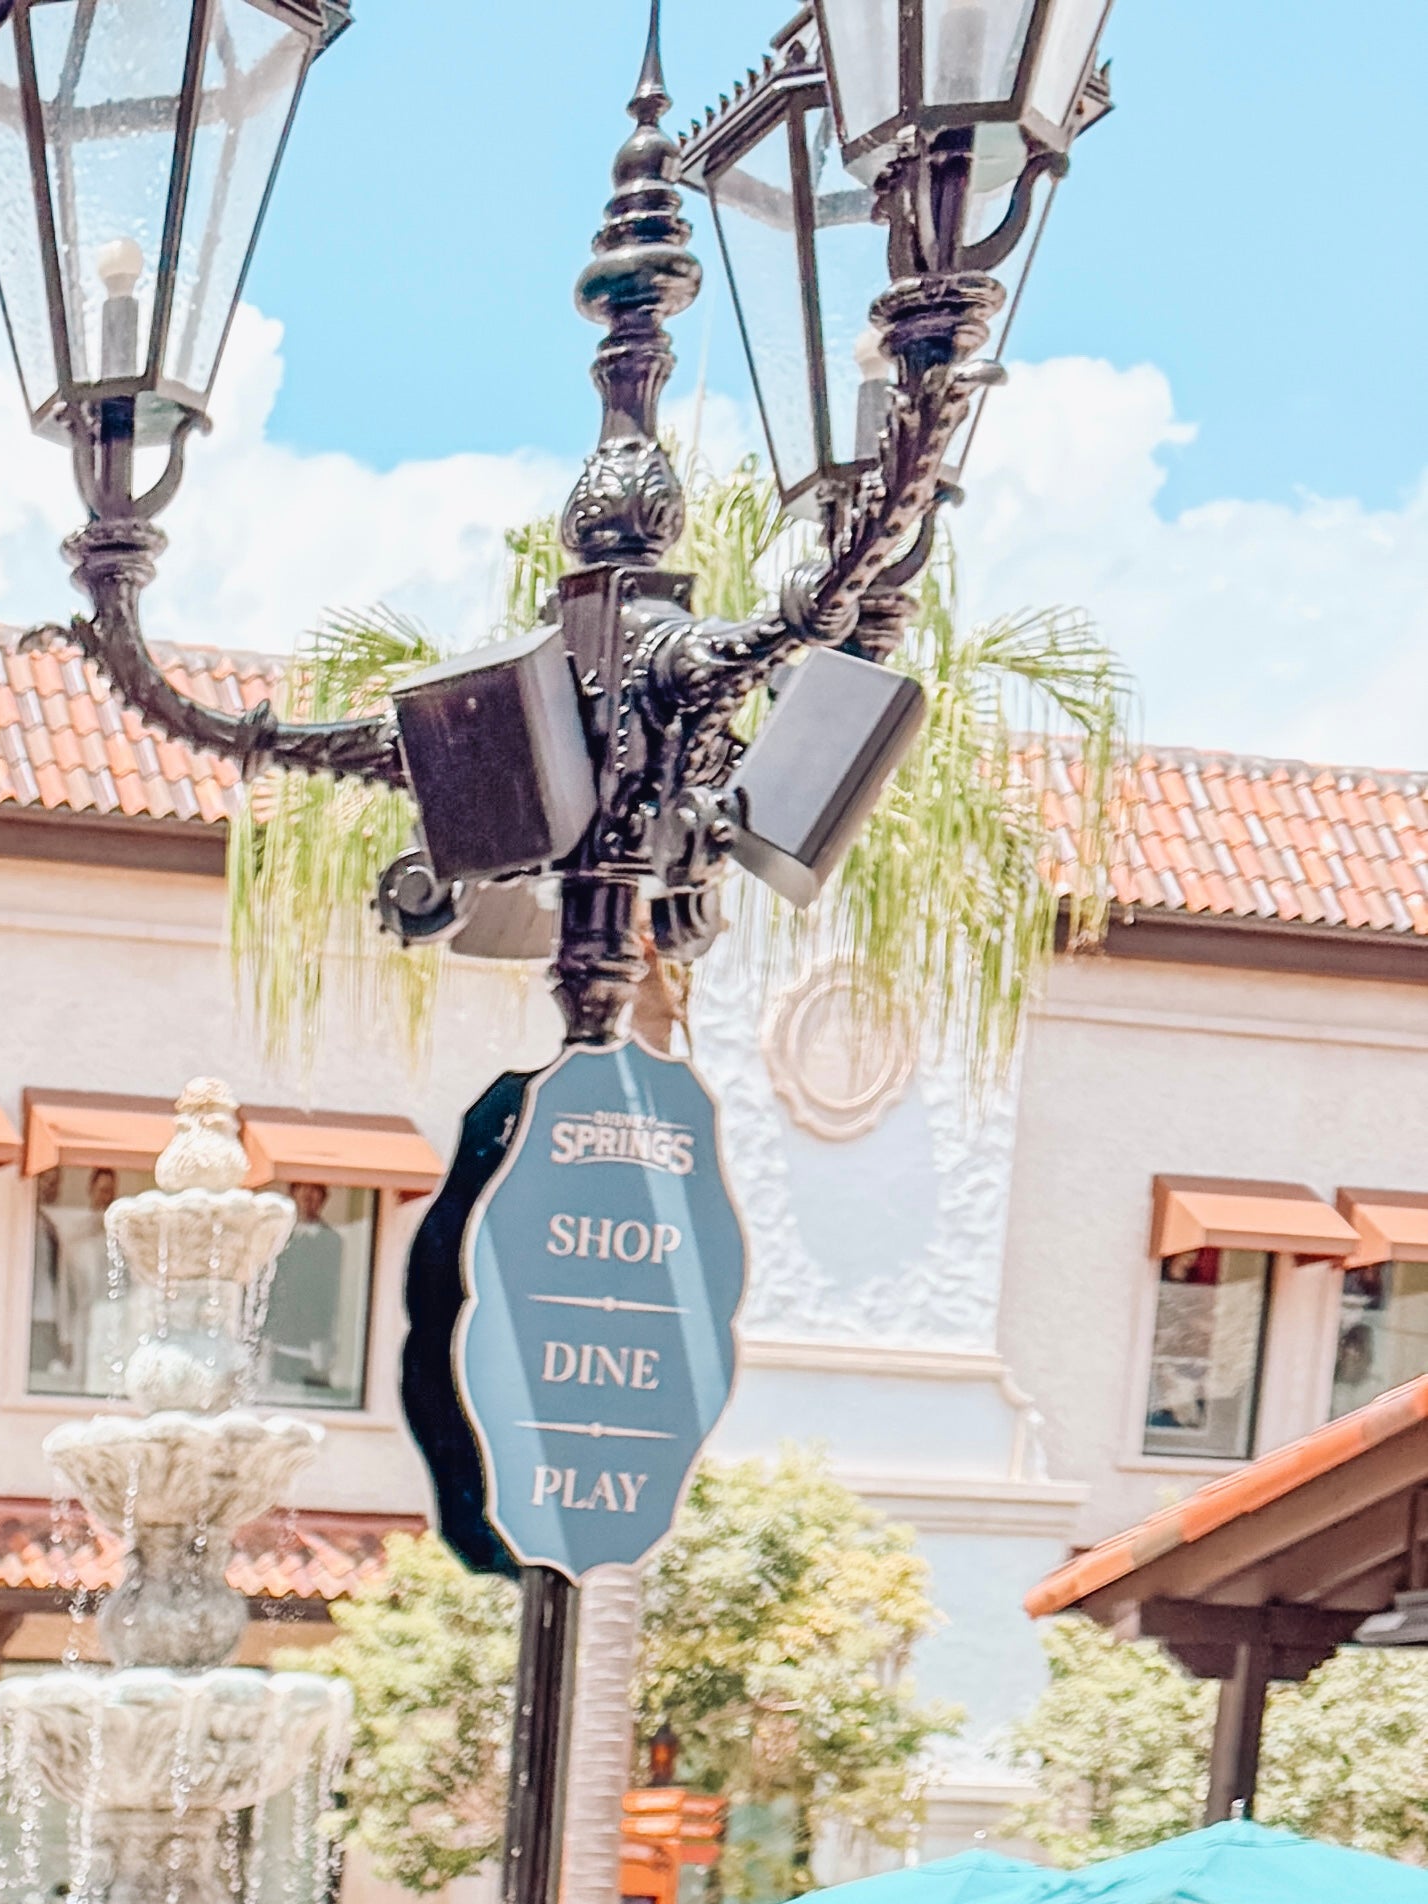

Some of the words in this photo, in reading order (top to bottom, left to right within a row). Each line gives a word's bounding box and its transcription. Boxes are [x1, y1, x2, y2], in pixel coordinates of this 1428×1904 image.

[550, 1121, 695, 1176] SPRINGS
[546, 1213, 683, 1264] SHOP
[541, 1340, 661, 1391] DINE
[530, 1465, 649, 1513] PLAY
